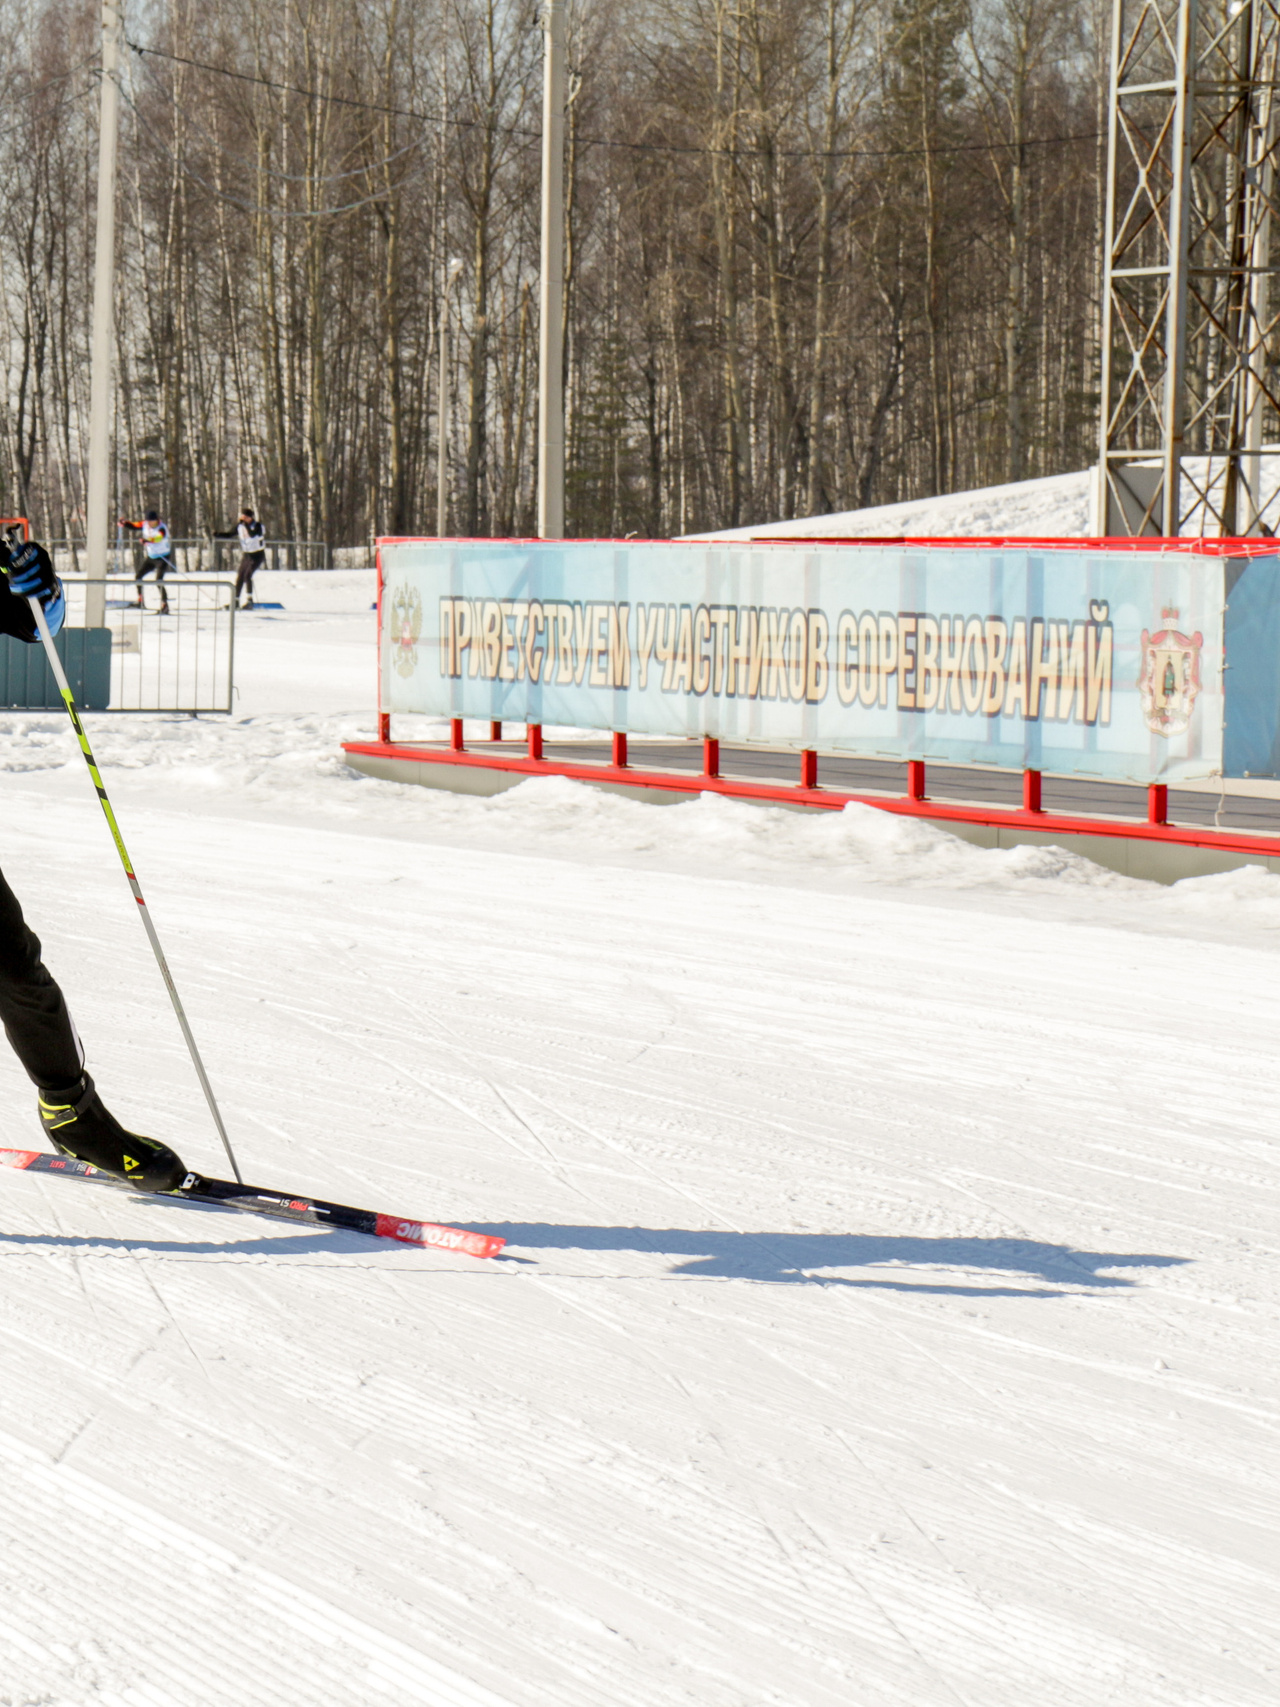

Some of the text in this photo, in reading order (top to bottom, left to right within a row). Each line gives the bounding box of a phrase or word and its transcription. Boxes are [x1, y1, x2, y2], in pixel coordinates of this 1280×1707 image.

[439, 596, 1114, 726] ПРИВЕТСТВУЕМ УЧАСТНИКОВ СОРЕВНОВАНИЙ
[289, 1200, 308, 1211] PRO
[396, 1222, 464, 1248] ATOMIC
